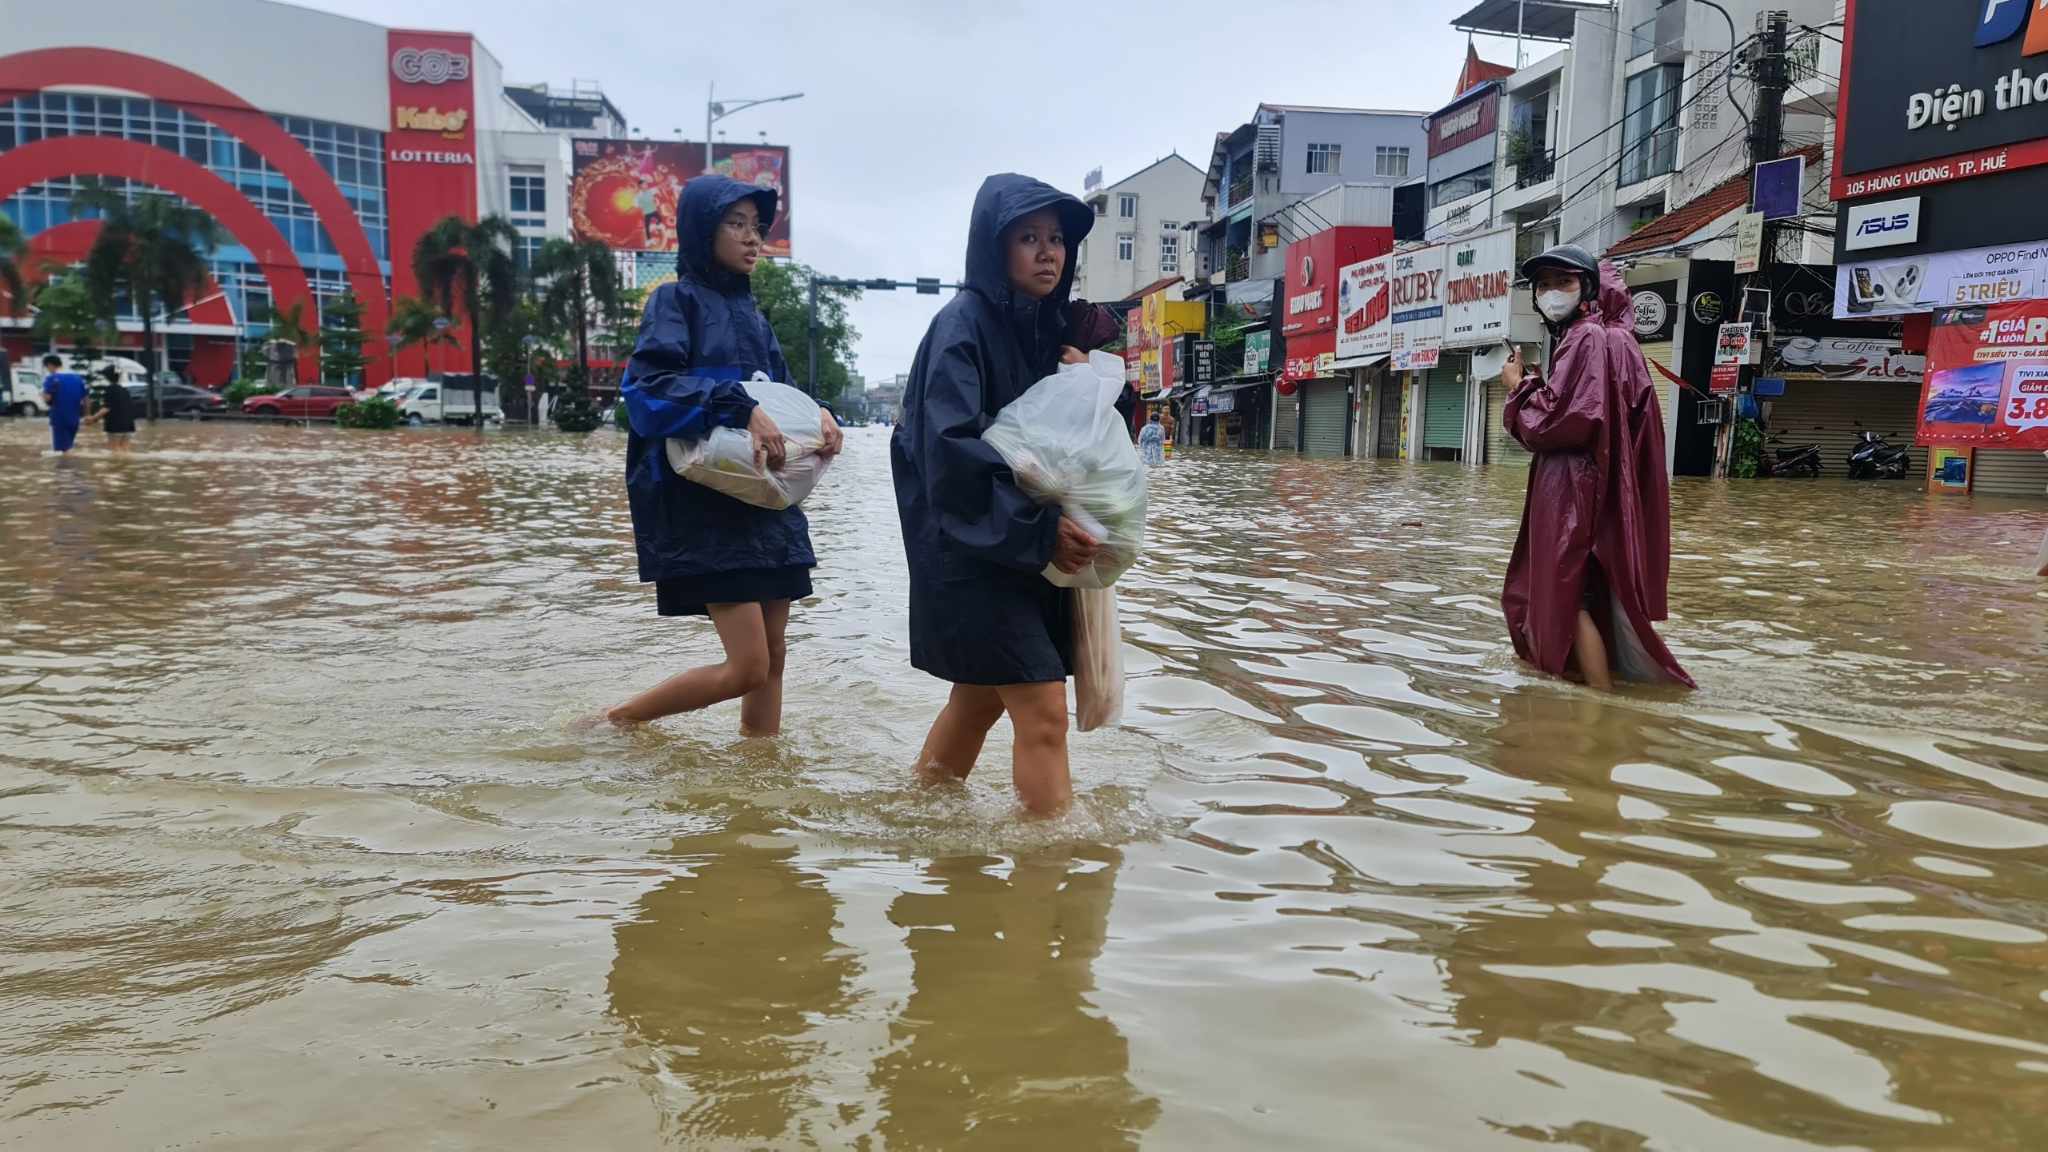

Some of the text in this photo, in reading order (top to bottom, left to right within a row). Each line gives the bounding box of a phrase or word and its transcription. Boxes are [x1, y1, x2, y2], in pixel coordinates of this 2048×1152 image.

[1906, 83, 1984, 131] Điện
[391, 149, 473, 164] LOTTERIA
[1846, 182, 1864, 195] 105
[1867, 173, 1901, 191] HÙNG
[1958, 161, 1977, 175] TP.
[1980, 148, 2008, 170] HUẾ
[1856, 213, 1910, 236] ASUS
[1986, 251, 2016, 265] OPPO
[2018, 245, 2039, 261] Find
[1391, 268, 1443, 306] RUBY
[1956, 285, 1966, 300] 5
[1634, 305, 1656, 316] Coffee
[1999, 315, 2026, 332] GIÁ
[1831, 340, 1884, 353] Coffee
[1996, 333, 2024, 343] LUÔN
[2008, 398, 2048, 420] 3.8
